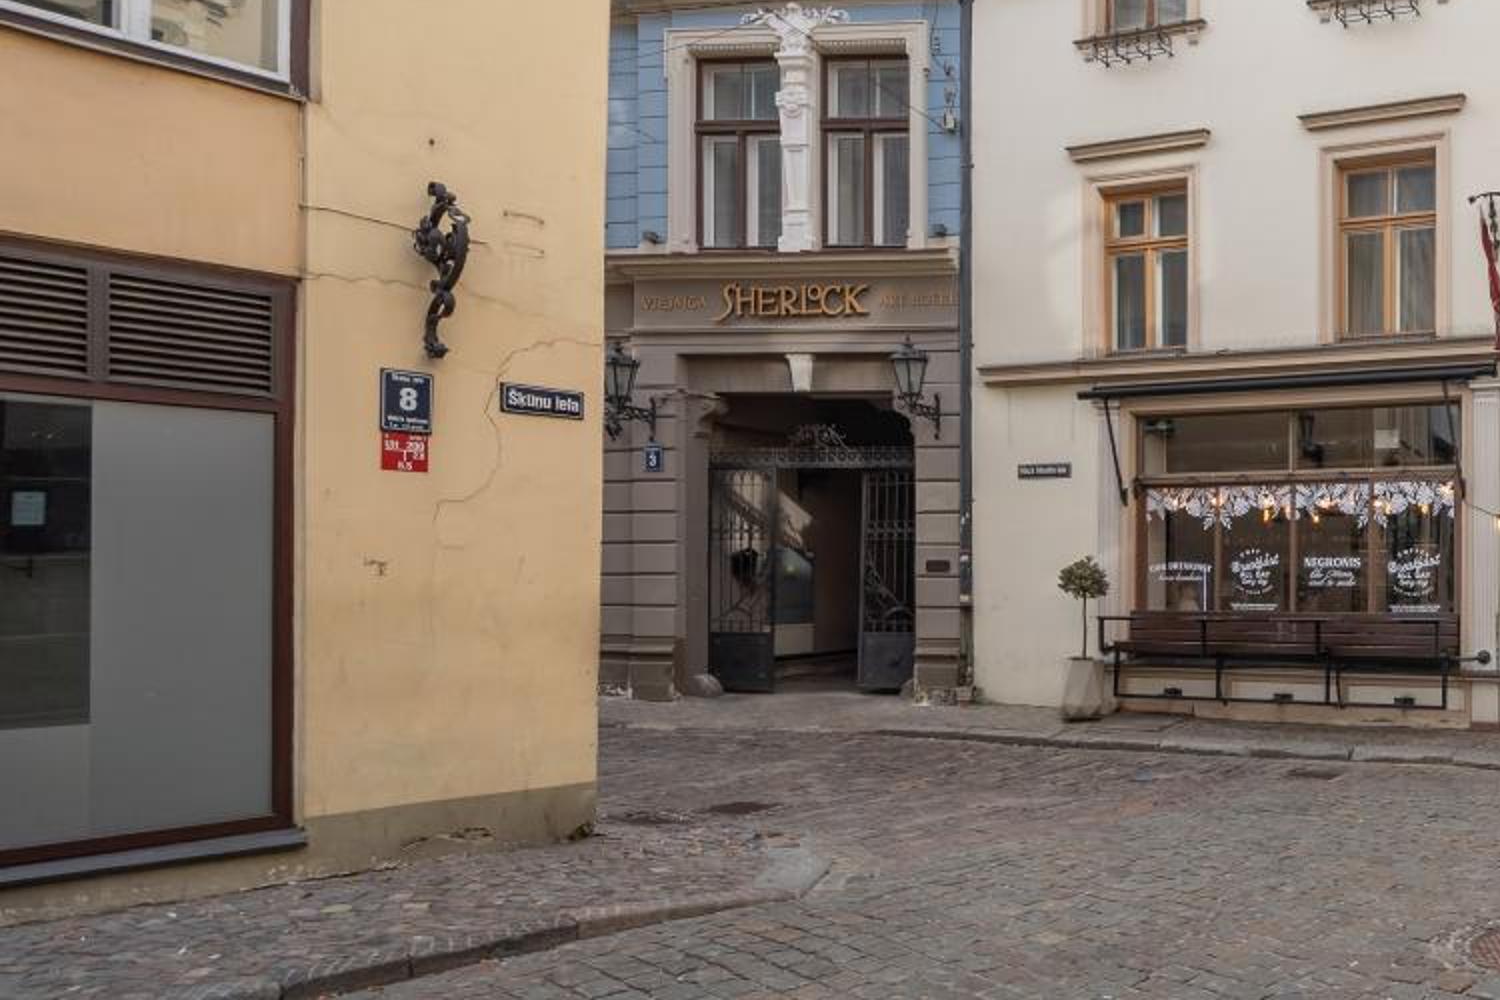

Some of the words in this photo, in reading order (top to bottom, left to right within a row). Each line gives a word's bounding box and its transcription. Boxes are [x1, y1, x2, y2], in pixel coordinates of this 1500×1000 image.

[712, 284, 870, 325] SHERLOCK
[400, 387, 418, 411] 8
[649, 454, 657, 467] 3
